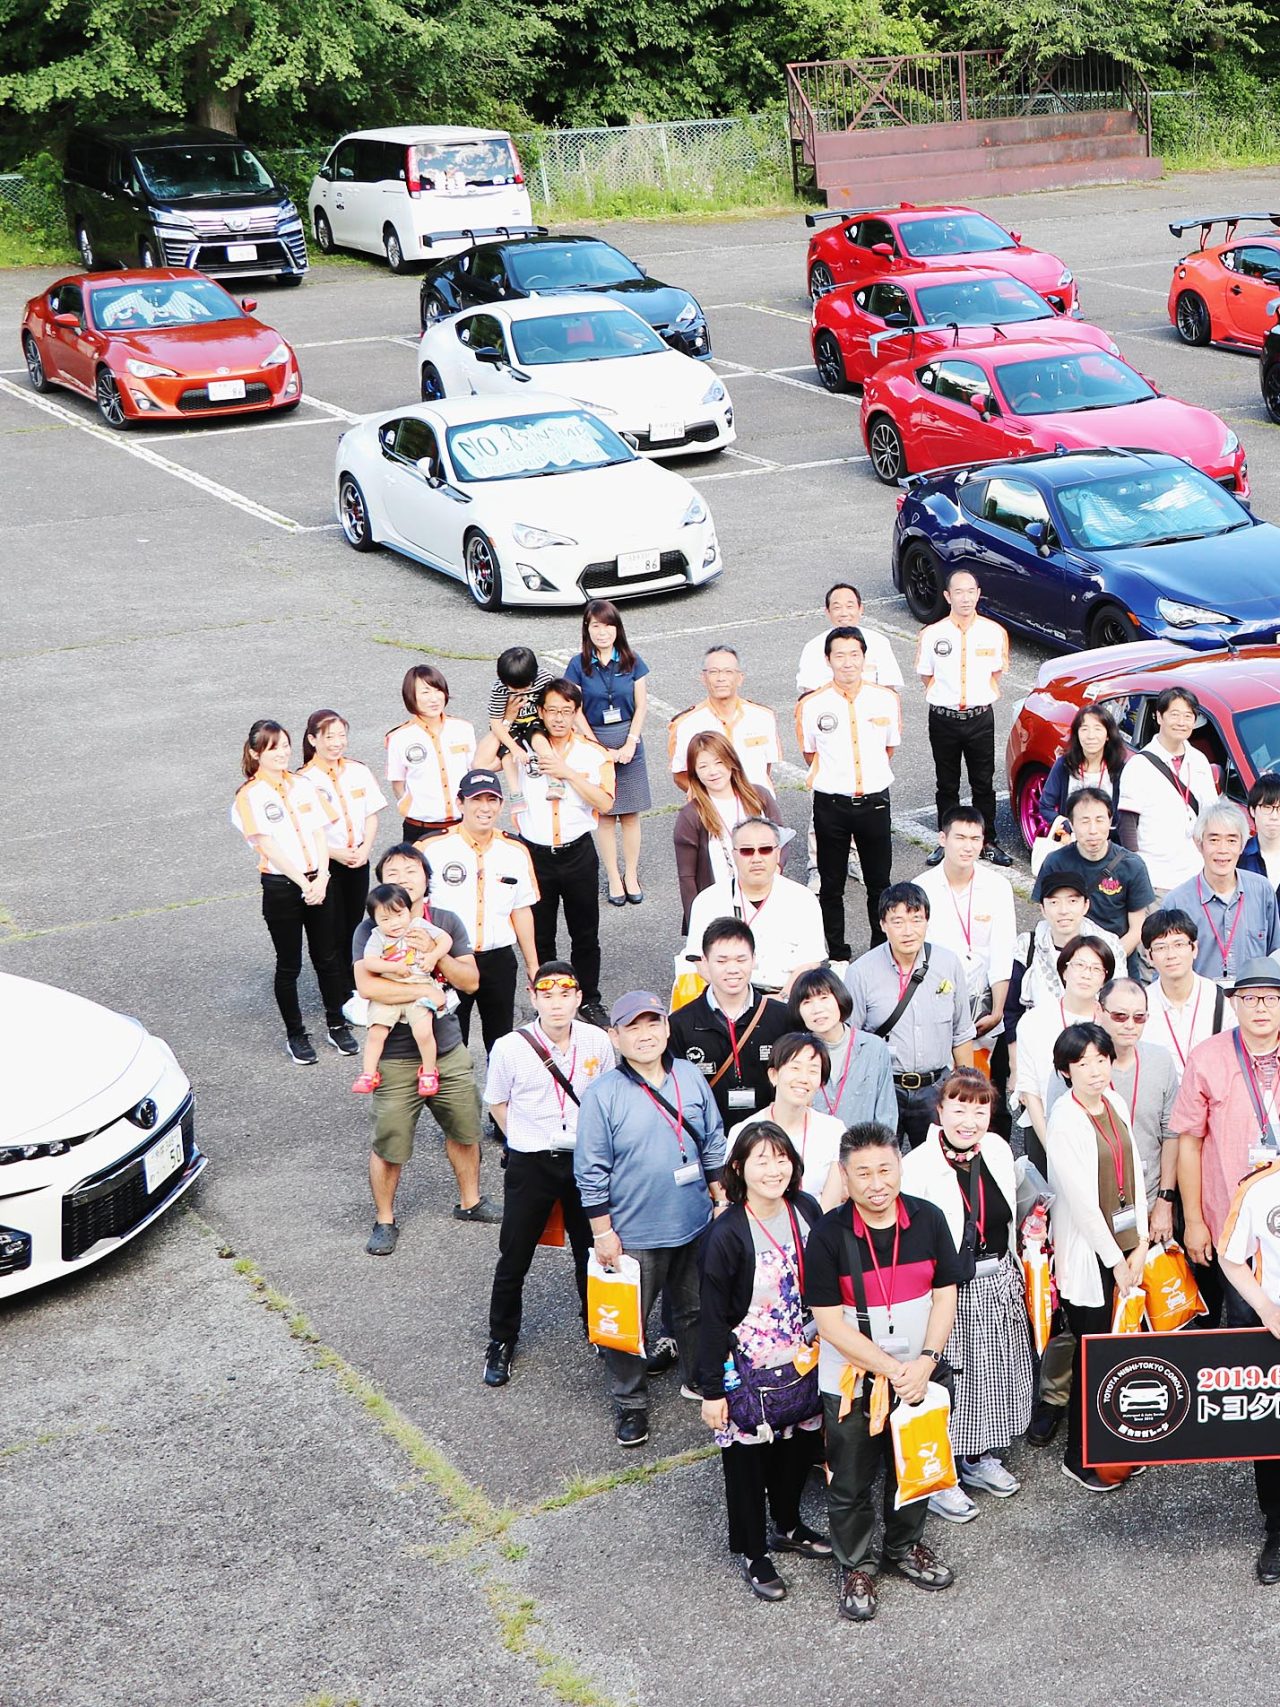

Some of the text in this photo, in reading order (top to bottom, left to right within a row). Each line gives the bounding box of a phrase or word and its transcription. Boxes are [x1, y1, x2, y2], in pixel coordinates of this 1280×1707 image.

[645, 560, 658, 571] 86
[170, 1144, 182, 1169] 50
[1103, 1362, 1184, 1404] TOYOTA NISHI-TOKYO COROLLA
